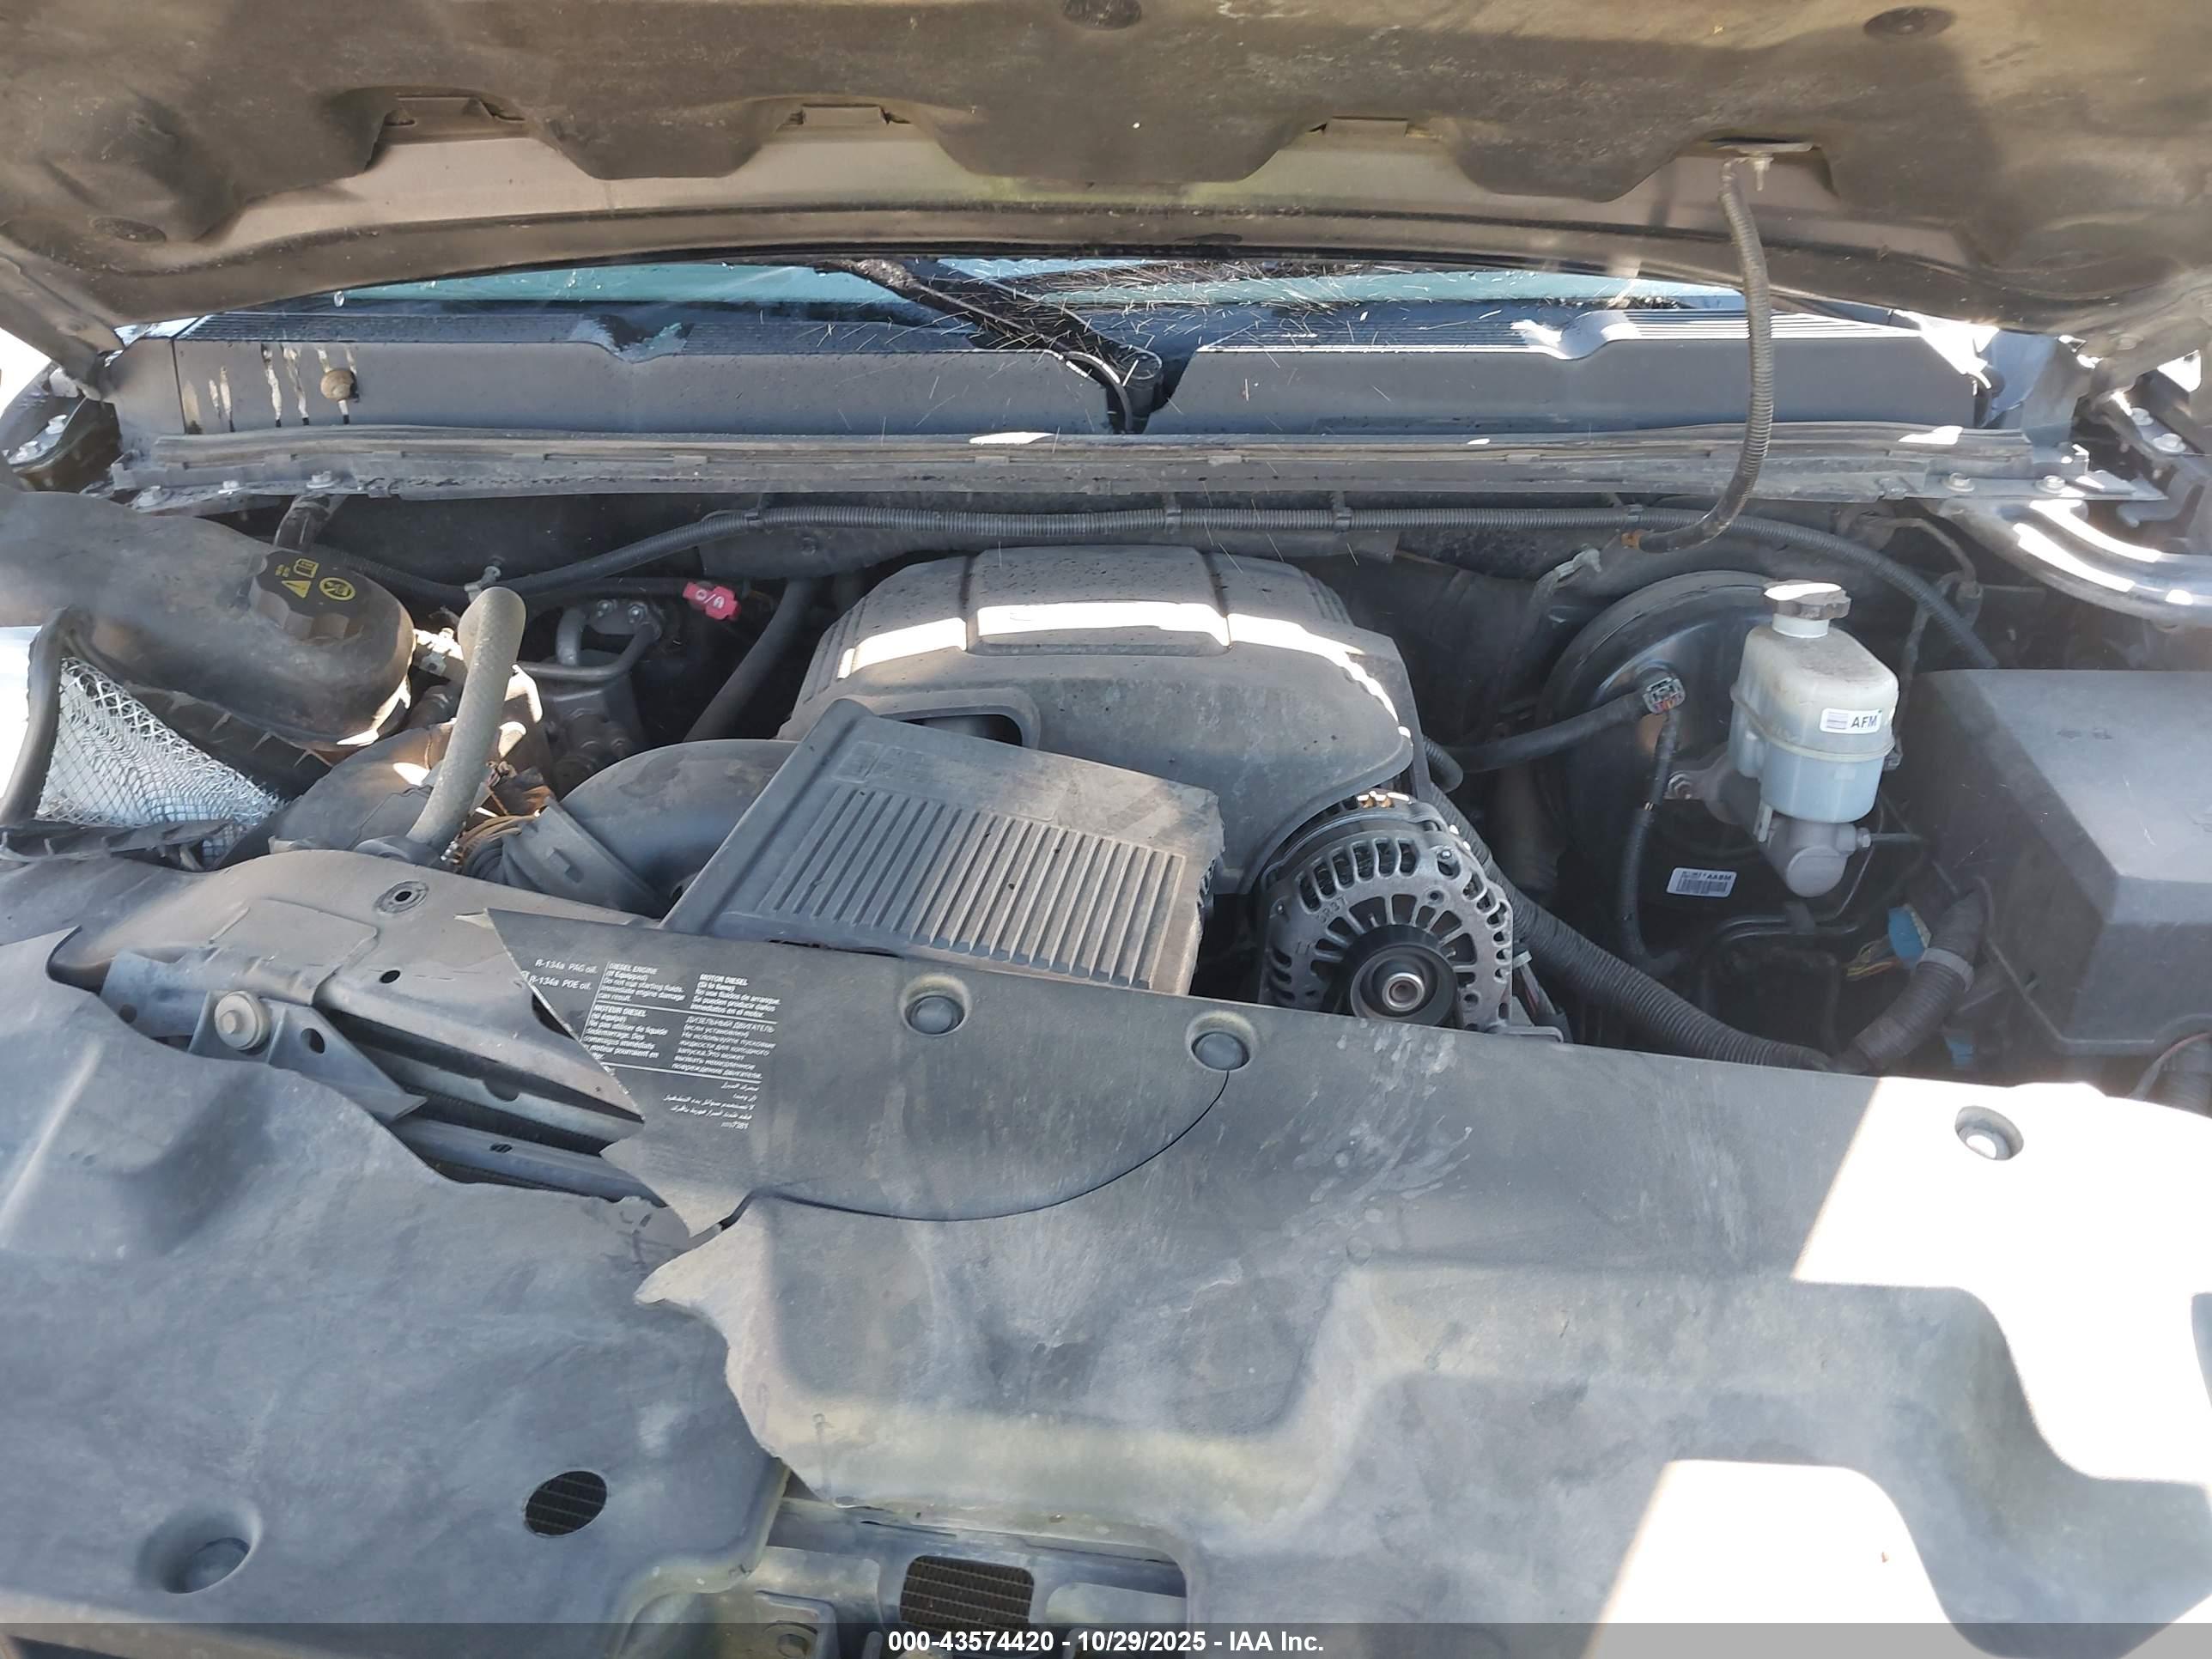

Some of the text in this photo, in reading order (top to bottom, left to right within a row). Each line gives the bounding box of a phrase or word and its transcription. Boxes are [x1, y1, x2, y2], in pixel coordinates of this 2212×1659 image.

[1850, 714, 1878, 729] AFM
[609, 963, 631, 971] DIESEL
[562, 979, 580, 988] POE
[700, 974, 747, 986] MOTOR DIESEL
[593, 1005, 646, 1017] MOTEUR DIESEL
